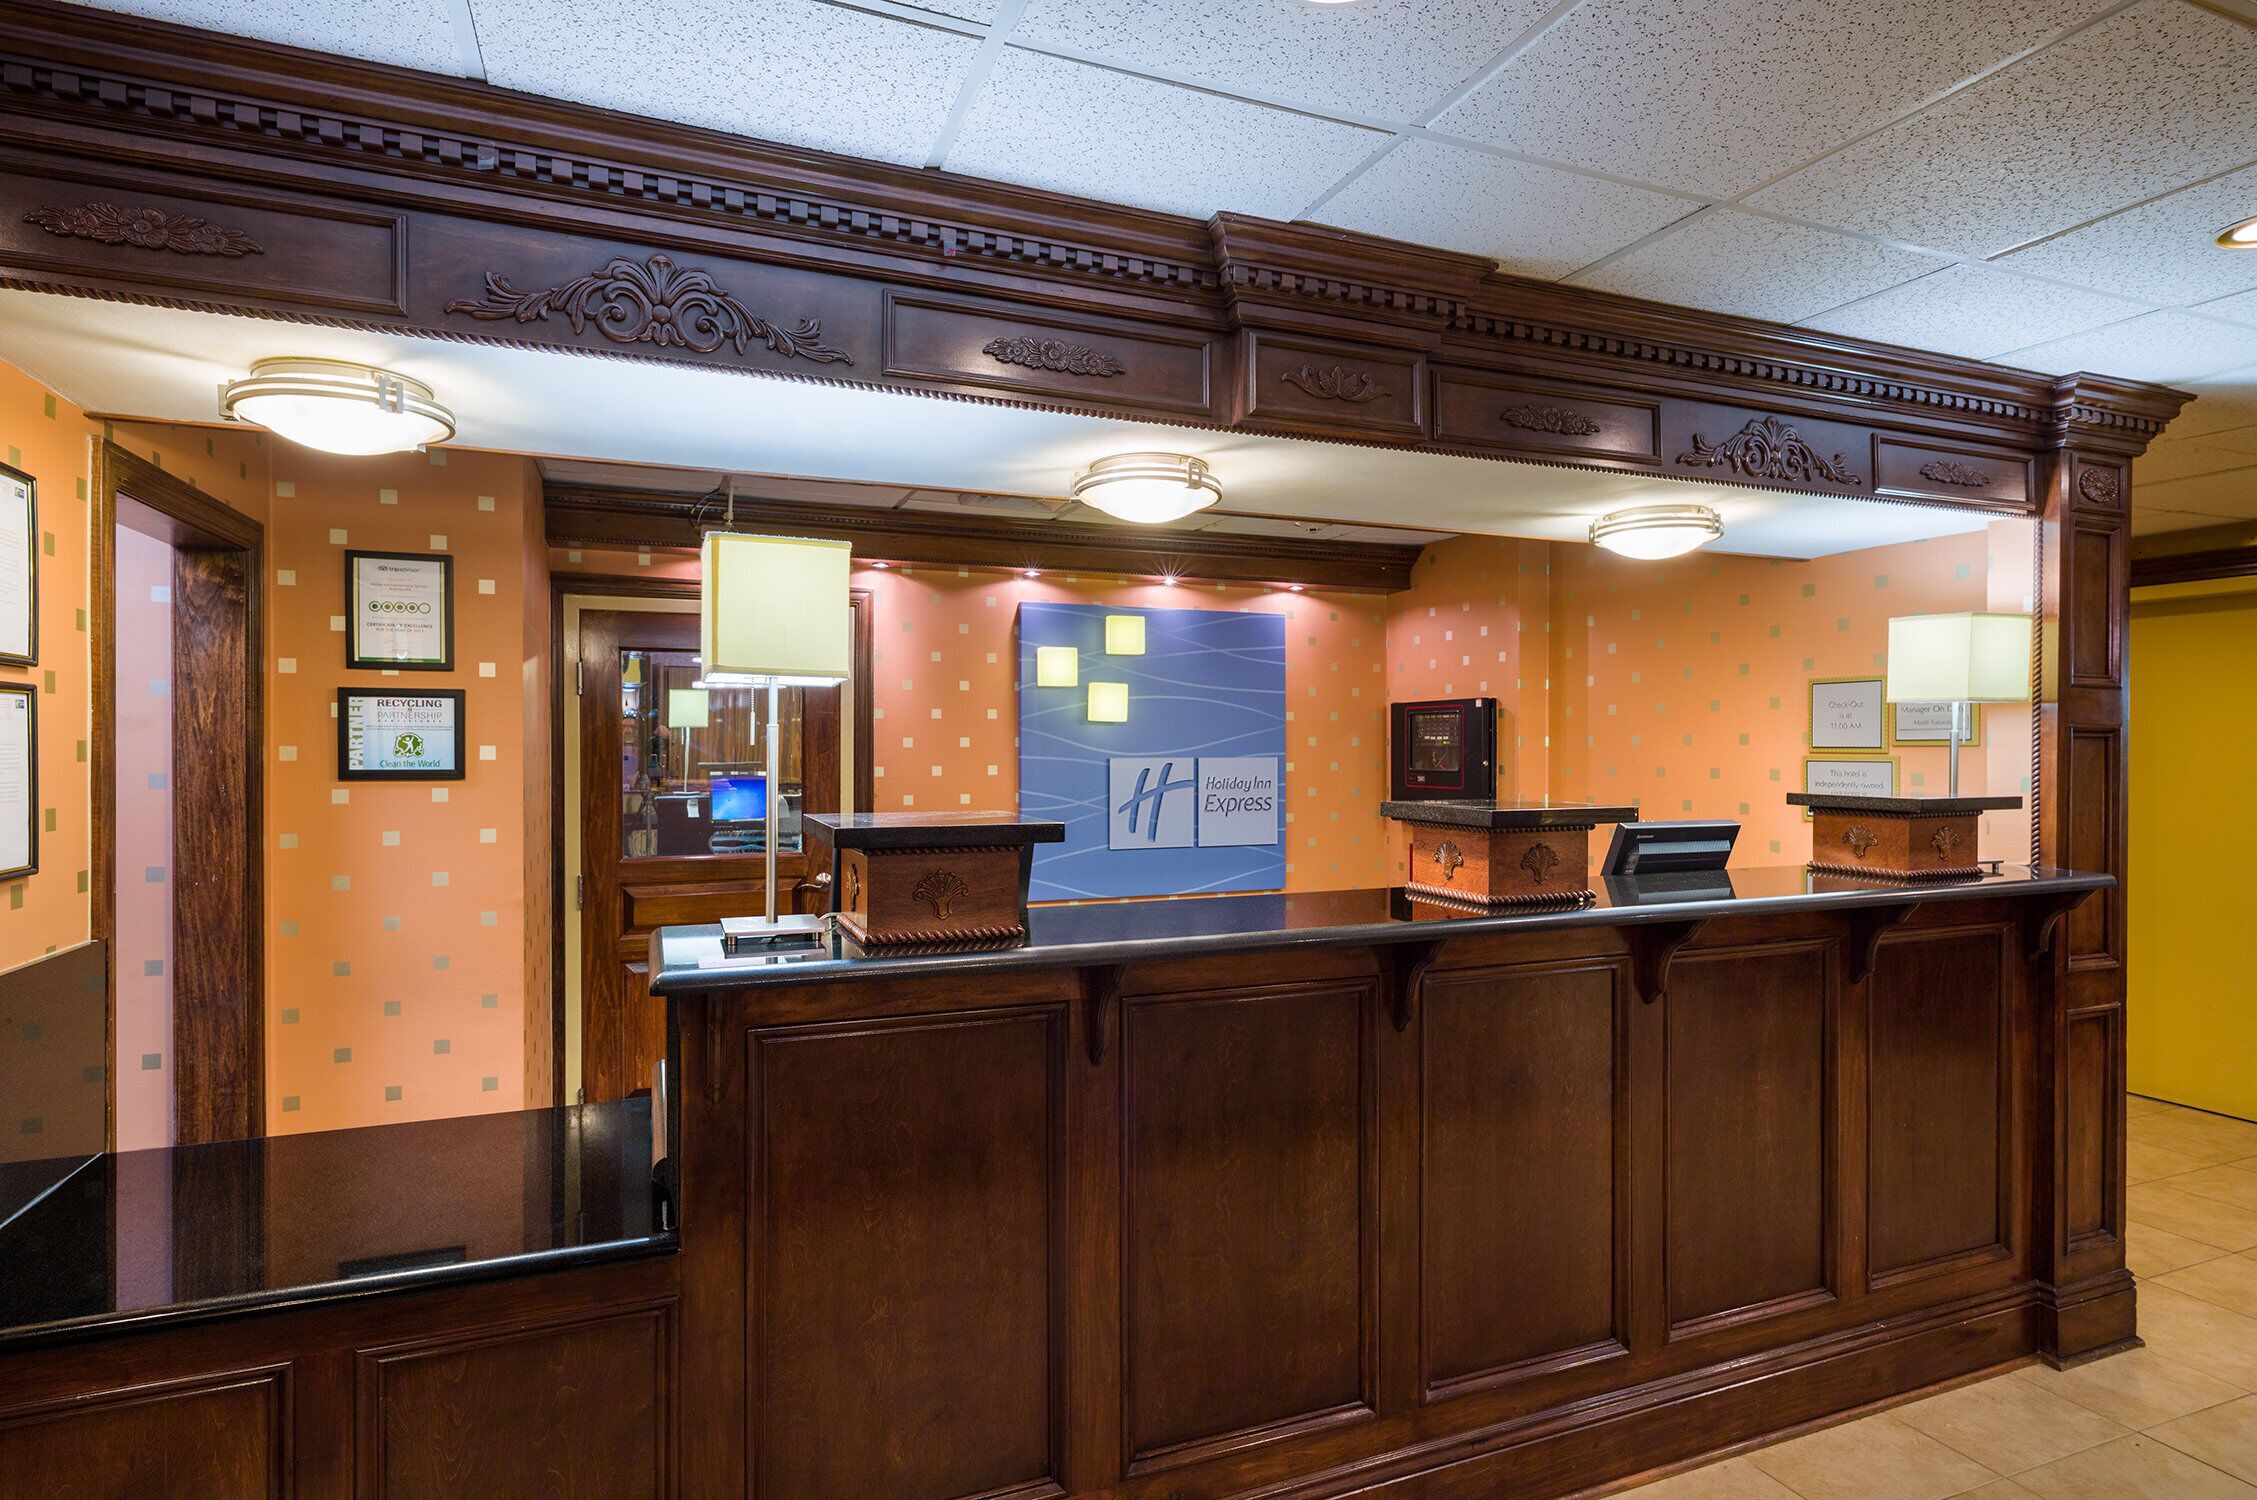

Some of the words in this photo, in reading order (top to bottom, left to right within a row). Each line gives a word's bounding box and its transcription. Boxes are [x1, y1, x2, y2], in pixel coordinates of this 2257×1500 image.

[377, 698, 443, 708] RECYCLING
[1829, 700, 1864, 708] Check-Out
[1901, 705, 1931, 714] Manager
[1932, 704, 1945, 713] On
[377, 711, 443, 720] PARTNERSHIP
[379, 759, 402, 768] Clean
[403, 759, 416, 768] the
[417, 759, 441, 768] World
[1830, 769, 1843, 777] This
[1844, 769, 1860, 777] hotel
[1205, 776, 1251, 792] Holiday
[1253, 776, 1272, 789] Inn
[1815, 780, 1859, 789] independently
[1860, 781, 1884, 790] owned
[1204, 793, 1272, 817] Express
